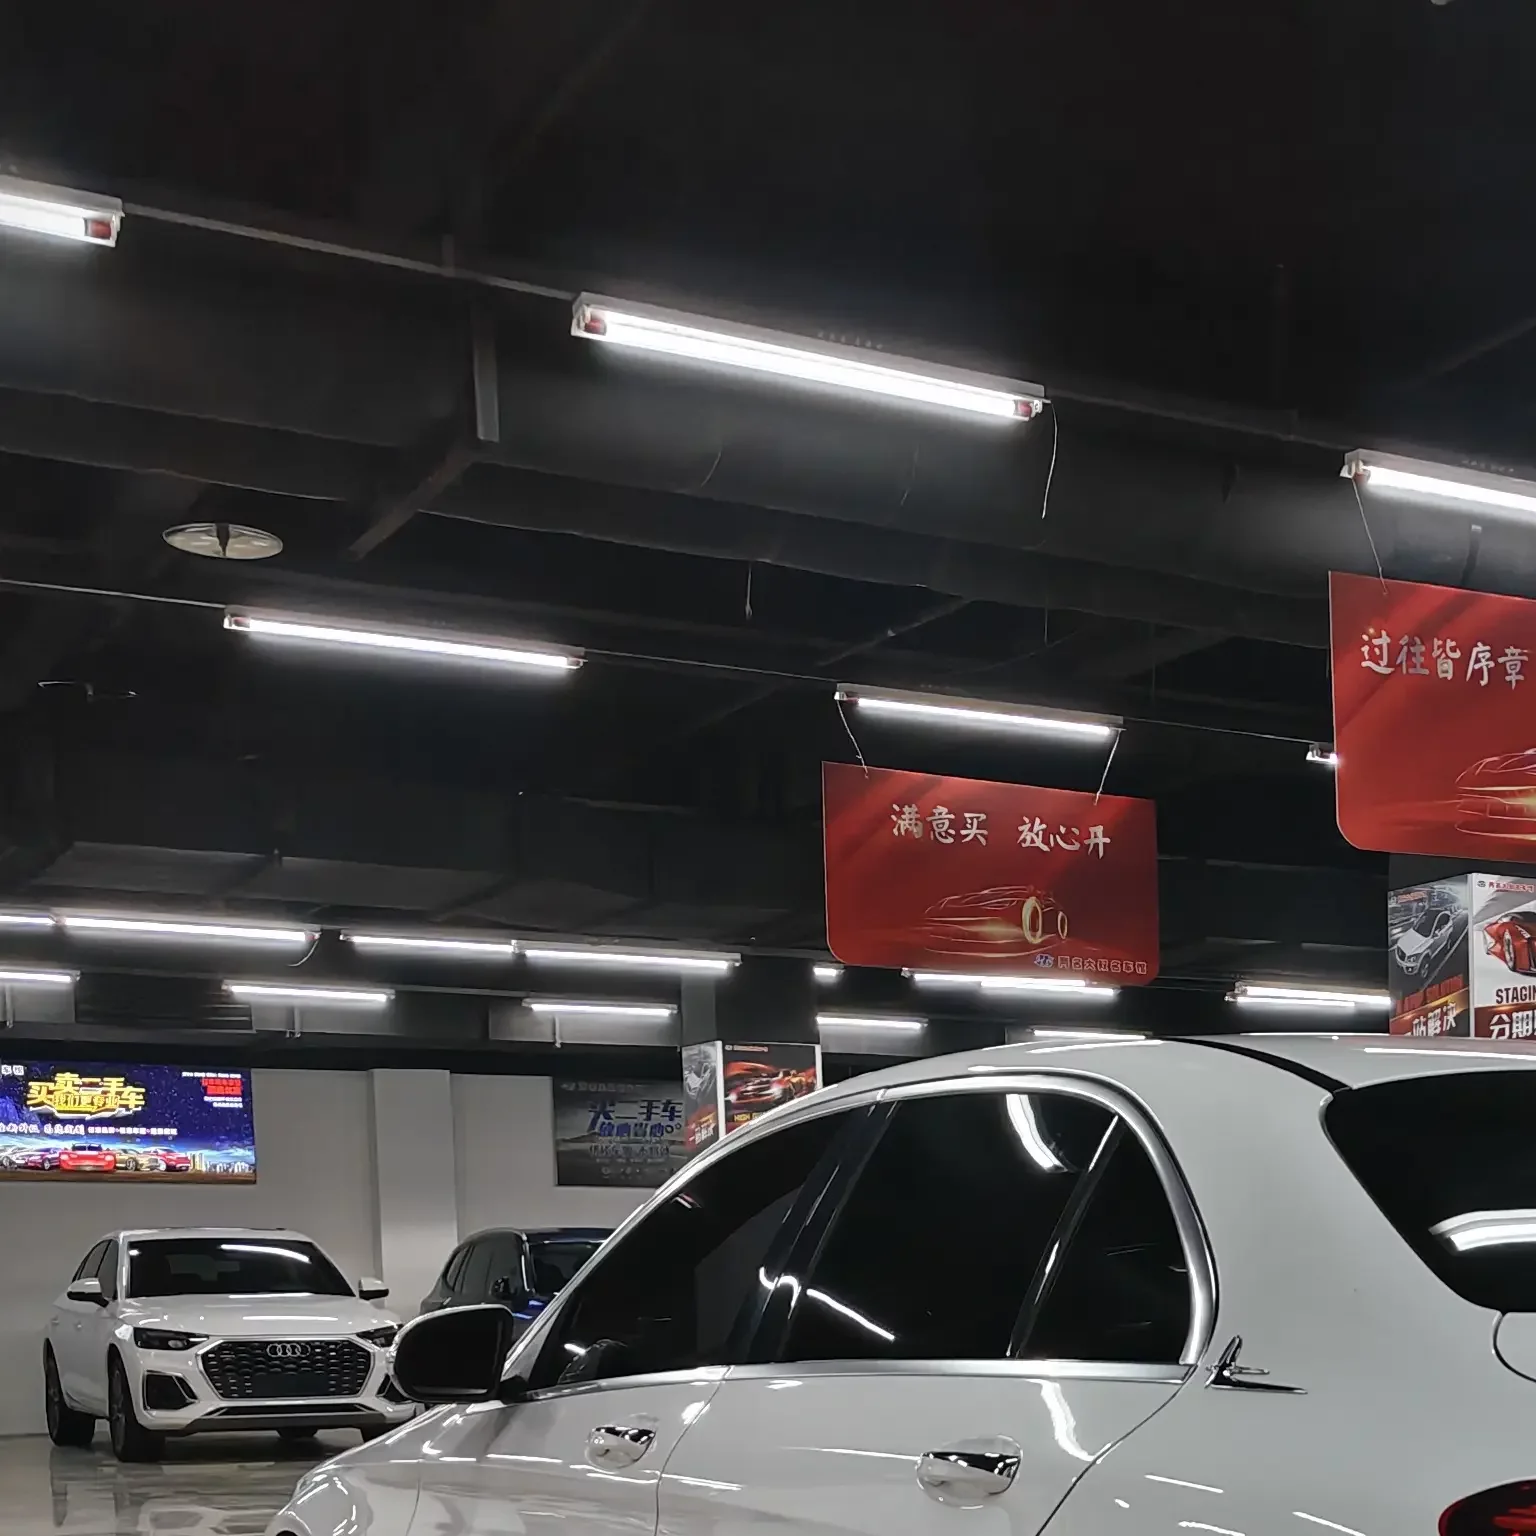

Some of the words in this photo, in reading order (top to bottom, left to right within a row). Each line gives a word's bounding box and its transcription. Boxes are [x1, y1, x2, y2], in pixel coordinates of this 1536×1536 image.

[1360, 630, 1529, 690] 过往皆序章
[890, 803, 989, 846] 满意买
[1016, 816, 1111, 859] 放心开
[26, 1072, 146, 1109] 买卖二手车
